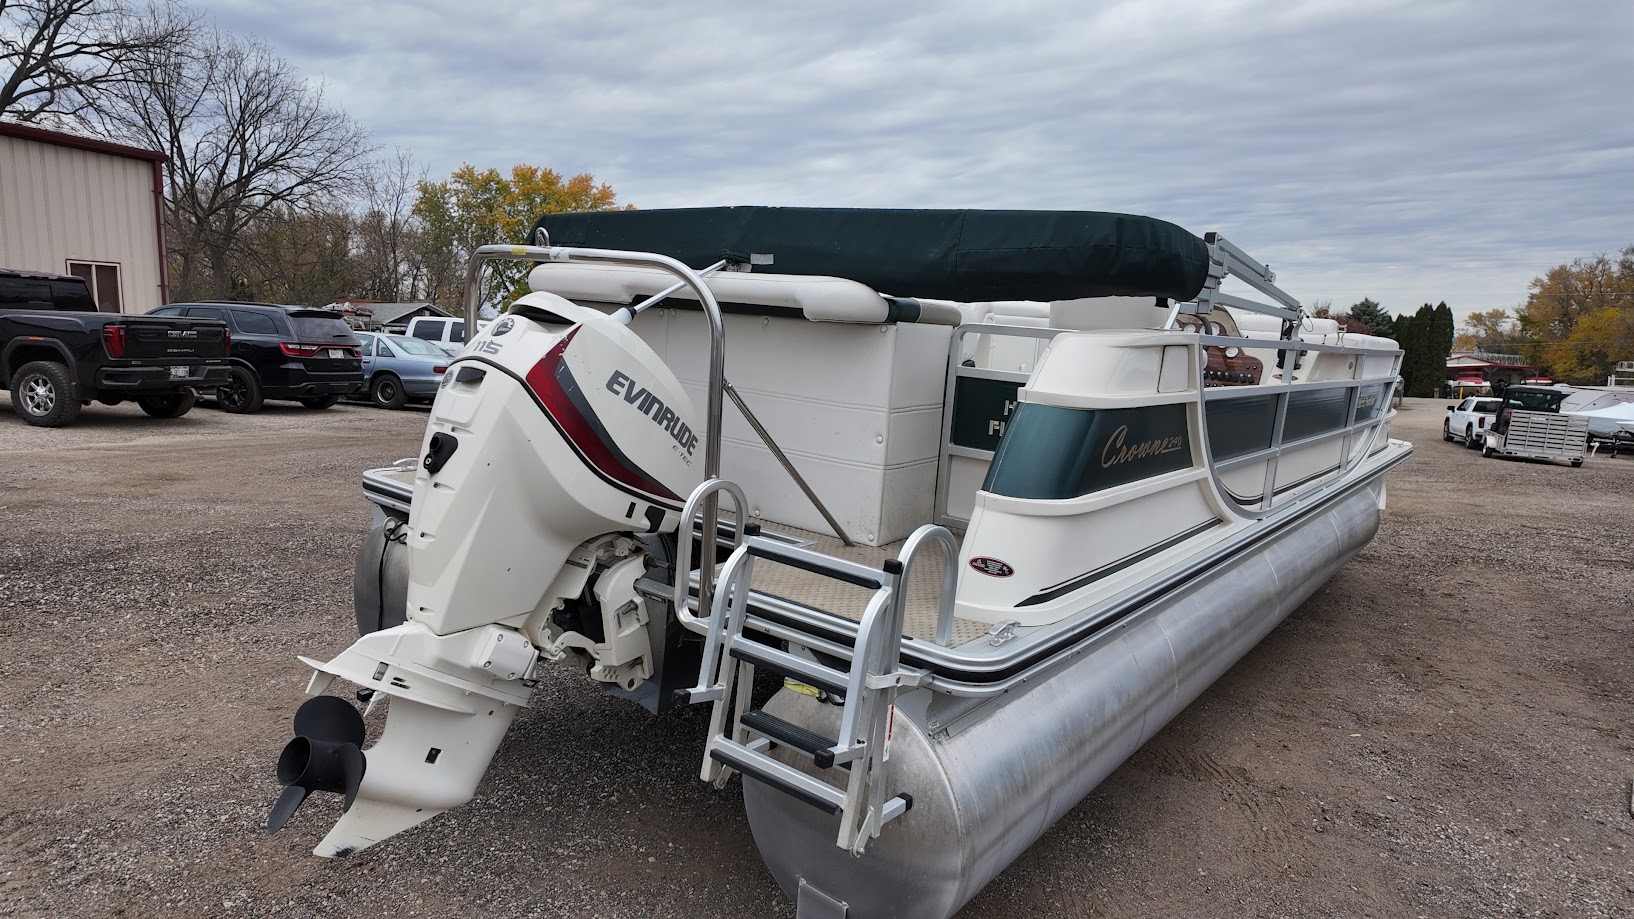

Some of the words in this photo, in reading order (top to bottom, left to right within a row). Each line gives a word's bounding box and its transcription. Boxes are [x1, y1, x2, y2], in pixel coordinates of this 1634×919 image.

[167, 330, 198, 338] GMC
[473, 340, 503, 355] 115
[605, 369, 699, 457] EVINRUDE
[672, 444, 692, 467] E-TEC
[1101, 424, 1172, 469] Crowne
